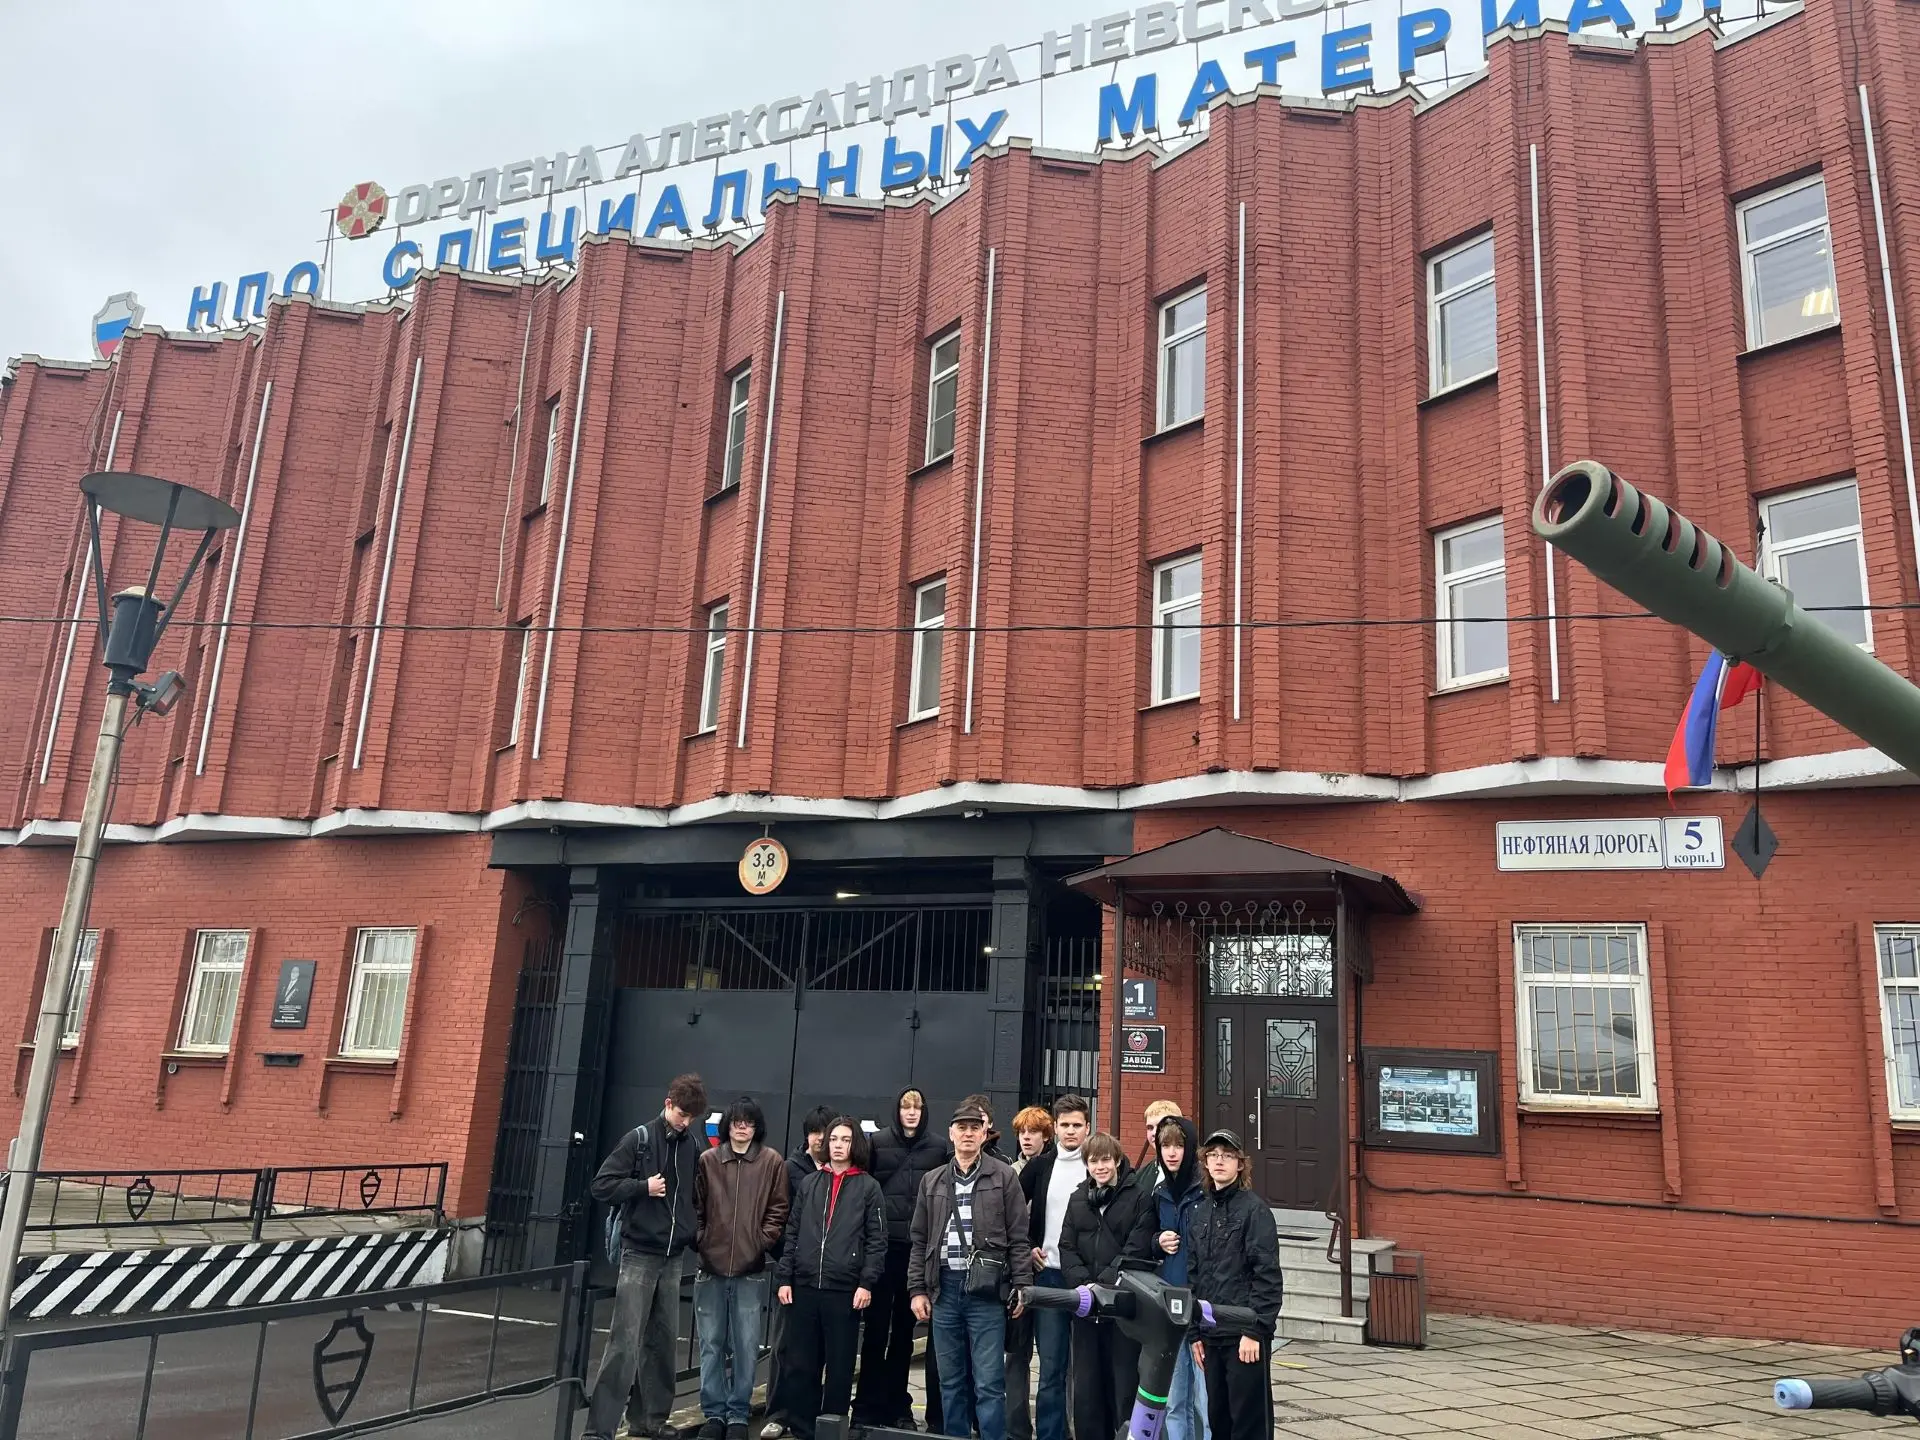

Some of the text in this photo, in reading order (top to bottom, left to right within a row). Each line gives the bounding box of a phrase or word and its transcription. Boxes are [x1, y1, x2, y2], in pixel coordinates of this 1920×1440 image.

[395, 0, 1348, 226] ОРДЕНА АЛЕКСАНДРА НЕВСК
[186, 261, 323, 332] НПО
[382, 108, 1009, 290] СПЕЦИАЛЬНЫХ
[1502, 821, 1704, 858] НЕФТЯНАЯ ДОРОГА 5
[752, 852, 775, 870] 3,8
[1674, 851, 1716, 866] корп.1
[757, 871, 766, 880] М
[1133, 982, 1144, 1004] 1
[1123, 1056, 1152, 1065] ЗАВОД
